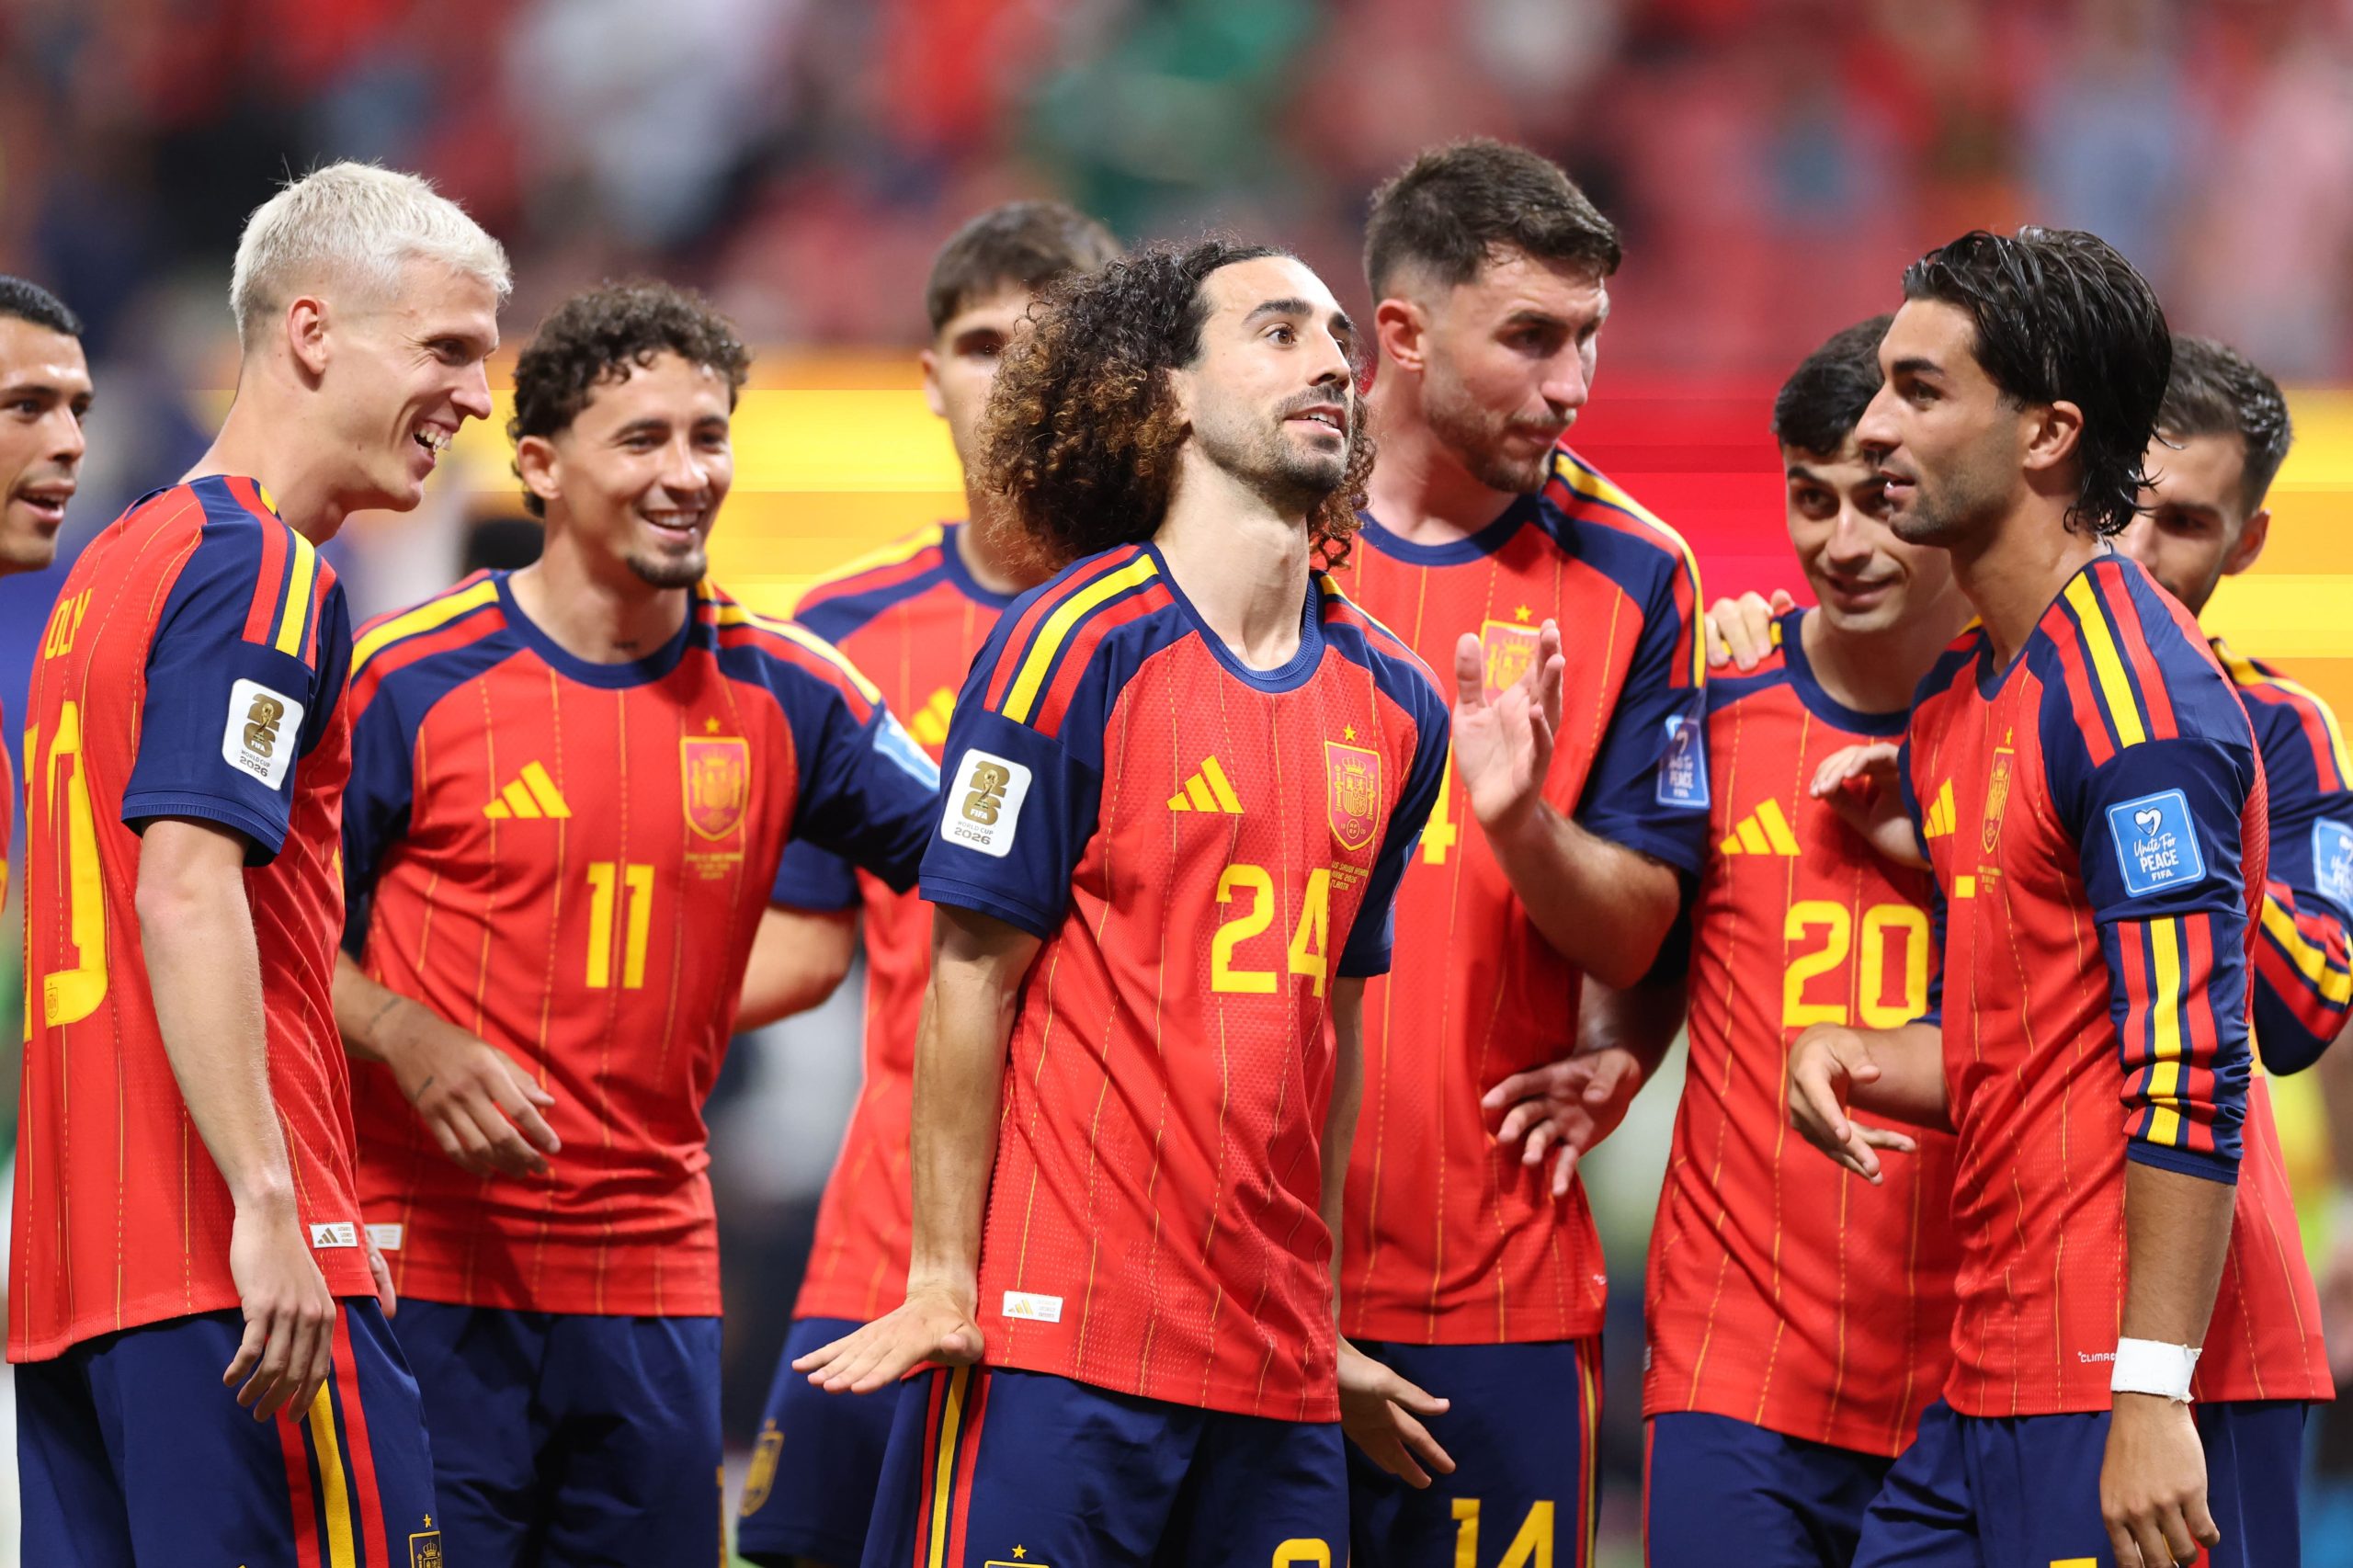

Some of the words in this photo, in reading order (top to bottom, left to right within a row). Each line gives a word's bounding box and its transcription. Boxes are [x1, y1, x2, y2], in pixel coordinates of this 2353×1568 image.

[44, 587, 92, 660] OLM
[239, 756, 268, 778] 2026
[241, 750, 259, 763] WORLD
[260, 758, 271, 767] CUP
[1418, 735, 1457, 865] 4
[970, 809, 988, 820] FIFA
[954, 826, 992, 846] 2026
[957, 821, 979, 832] WORLD
[980, 827, 994, 835] CUP
[2133, 838, 2160, 858] Unite
[2159, 833, 2177, 850] For
[2140, 849, 2179, 873] PEACE
[2152, 869, 2174, 881] FIFA
[585, 861, 655, 990] 11
[1211, 863, 1331, 998] 24
[1783, 900, 1928, 1030] 20
[2080, 1352, 2117, 1363] CLIMAC
